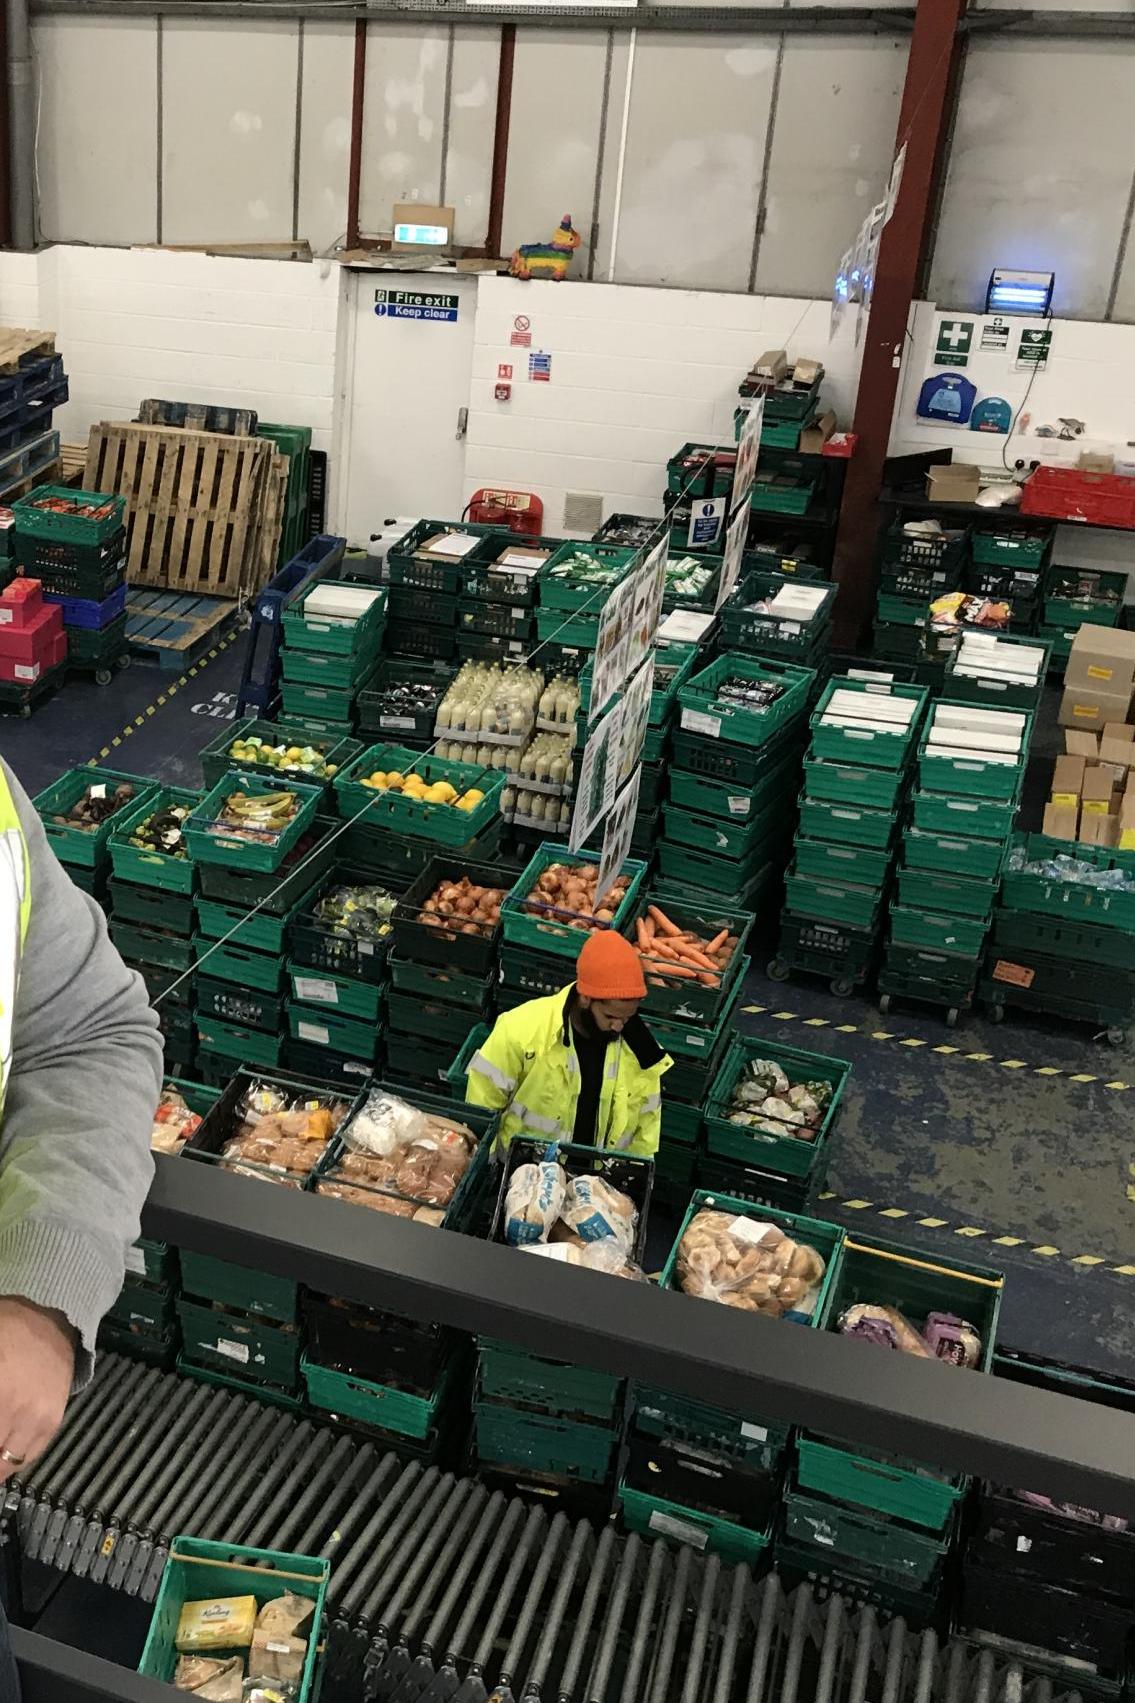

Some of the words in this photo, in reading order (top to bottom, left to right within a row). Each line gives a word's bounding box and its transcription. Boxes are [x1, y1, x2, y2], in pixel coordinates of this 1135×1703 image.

[395, 292, 422, 305] Fire
[425, 295, 451, 307] exit
[395, 306, 422, 318] Keep
[424, 308, 451, 319] clear
